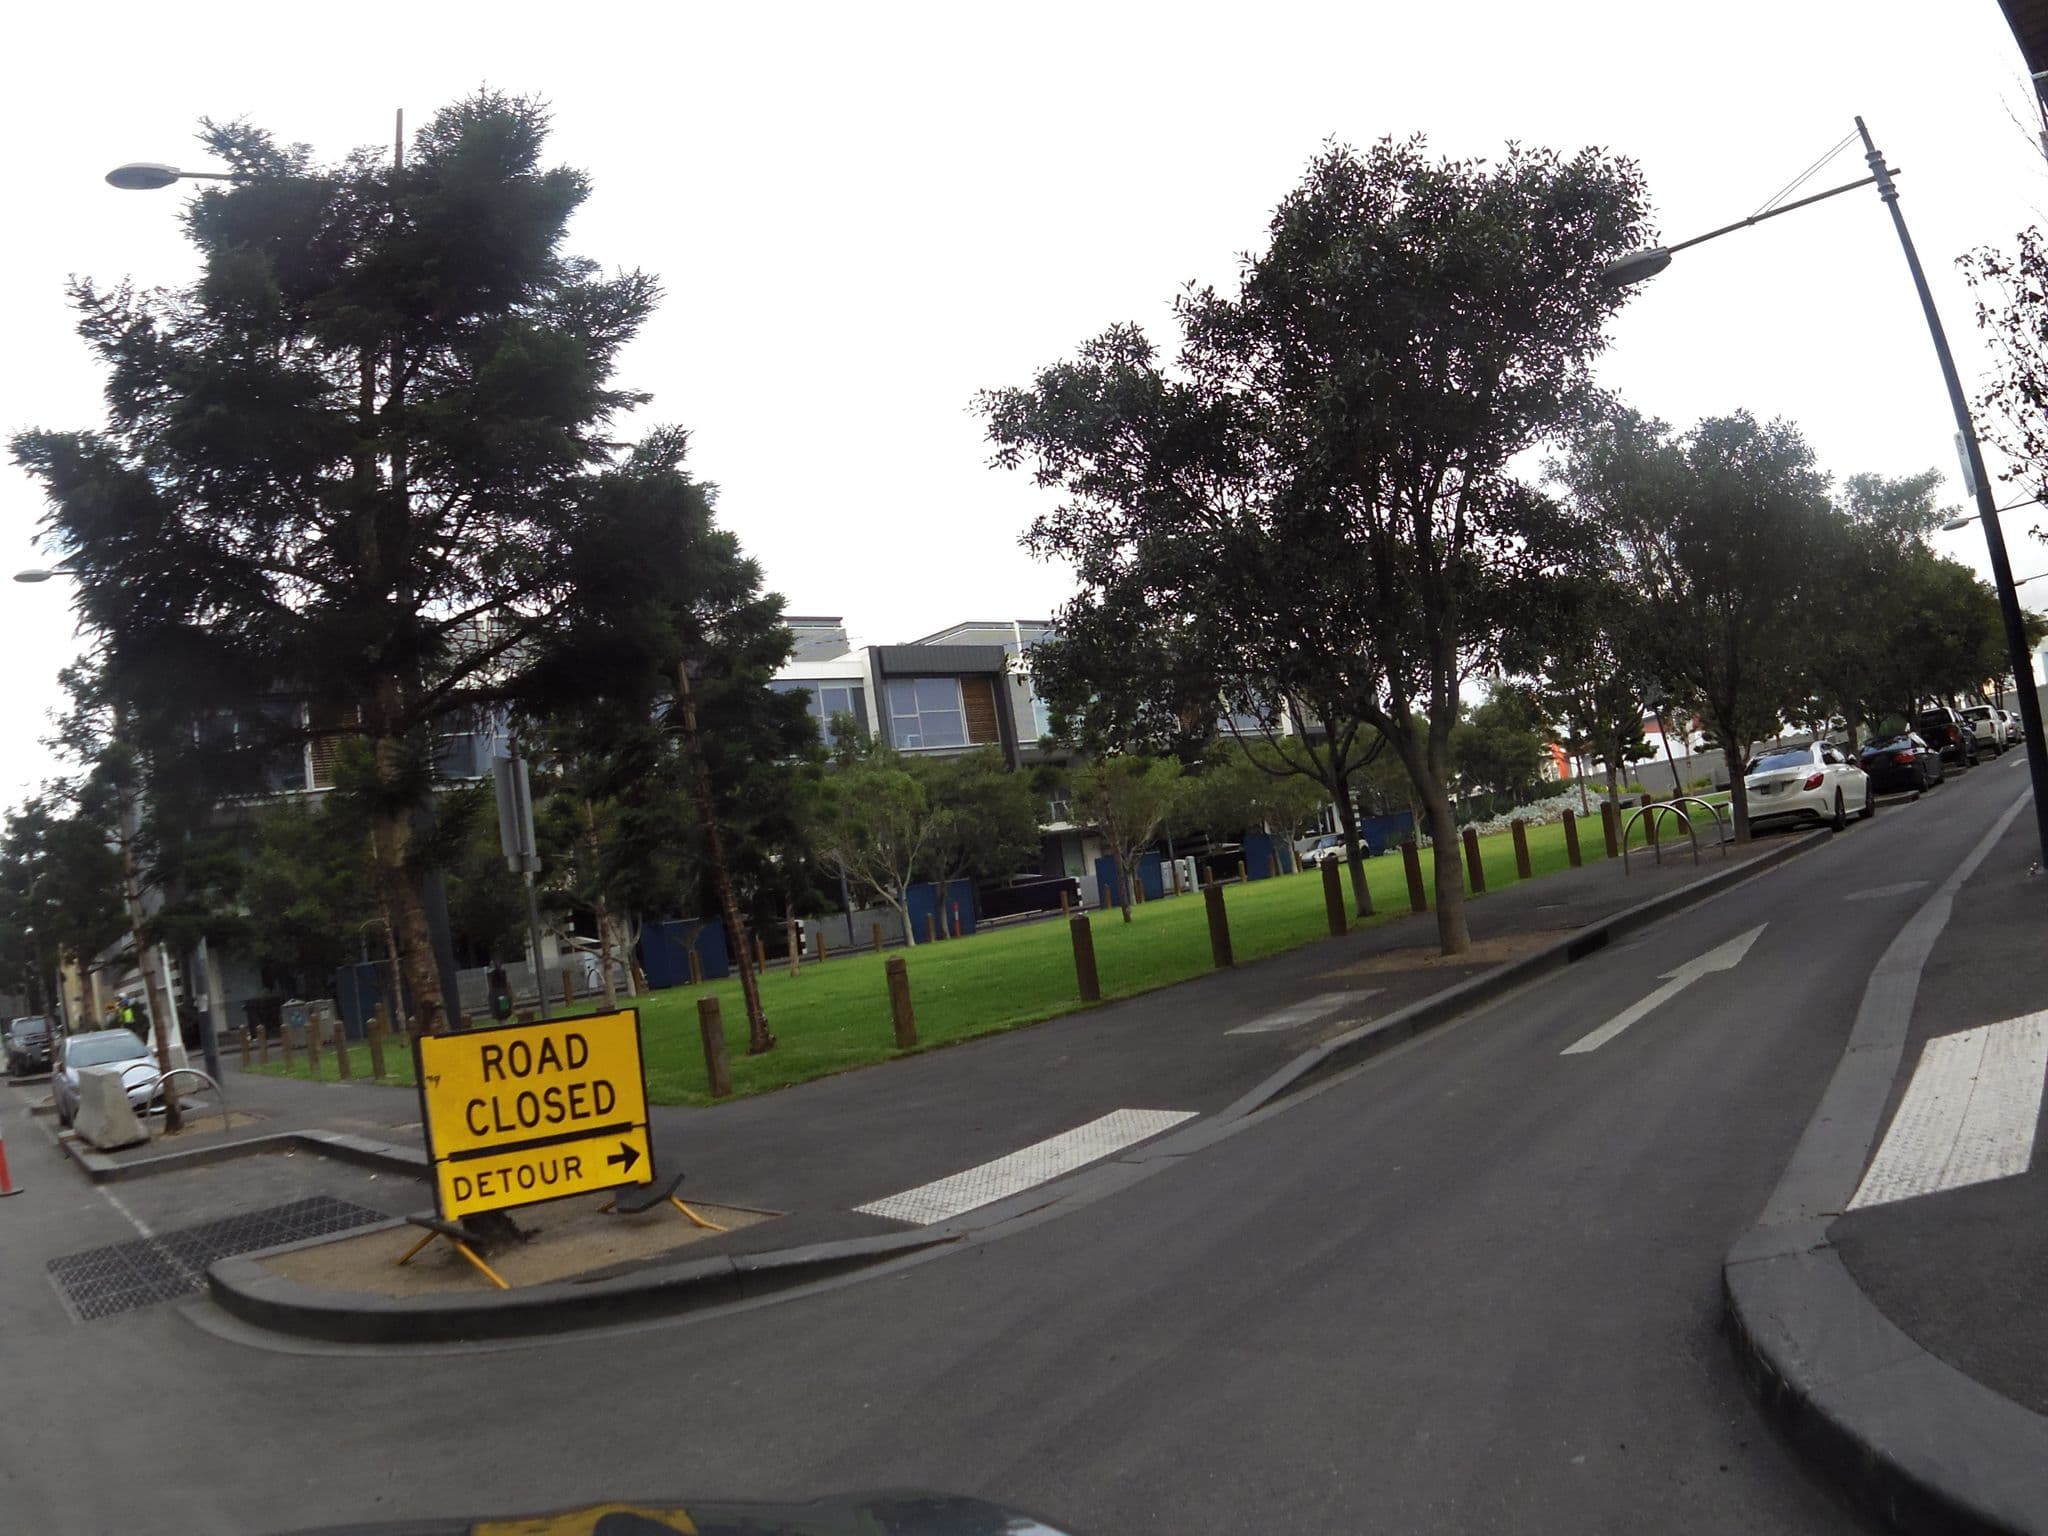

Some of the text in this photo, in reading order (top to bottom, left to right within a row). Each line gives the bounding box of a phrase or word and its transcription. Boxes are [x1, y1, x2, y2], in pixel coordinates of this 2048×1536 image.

[481, 1033, 588, 1082] ROAD
[466, 1080, 616, 1136] CLOSED
[453, 1156, 583, 1201] DETOUR
